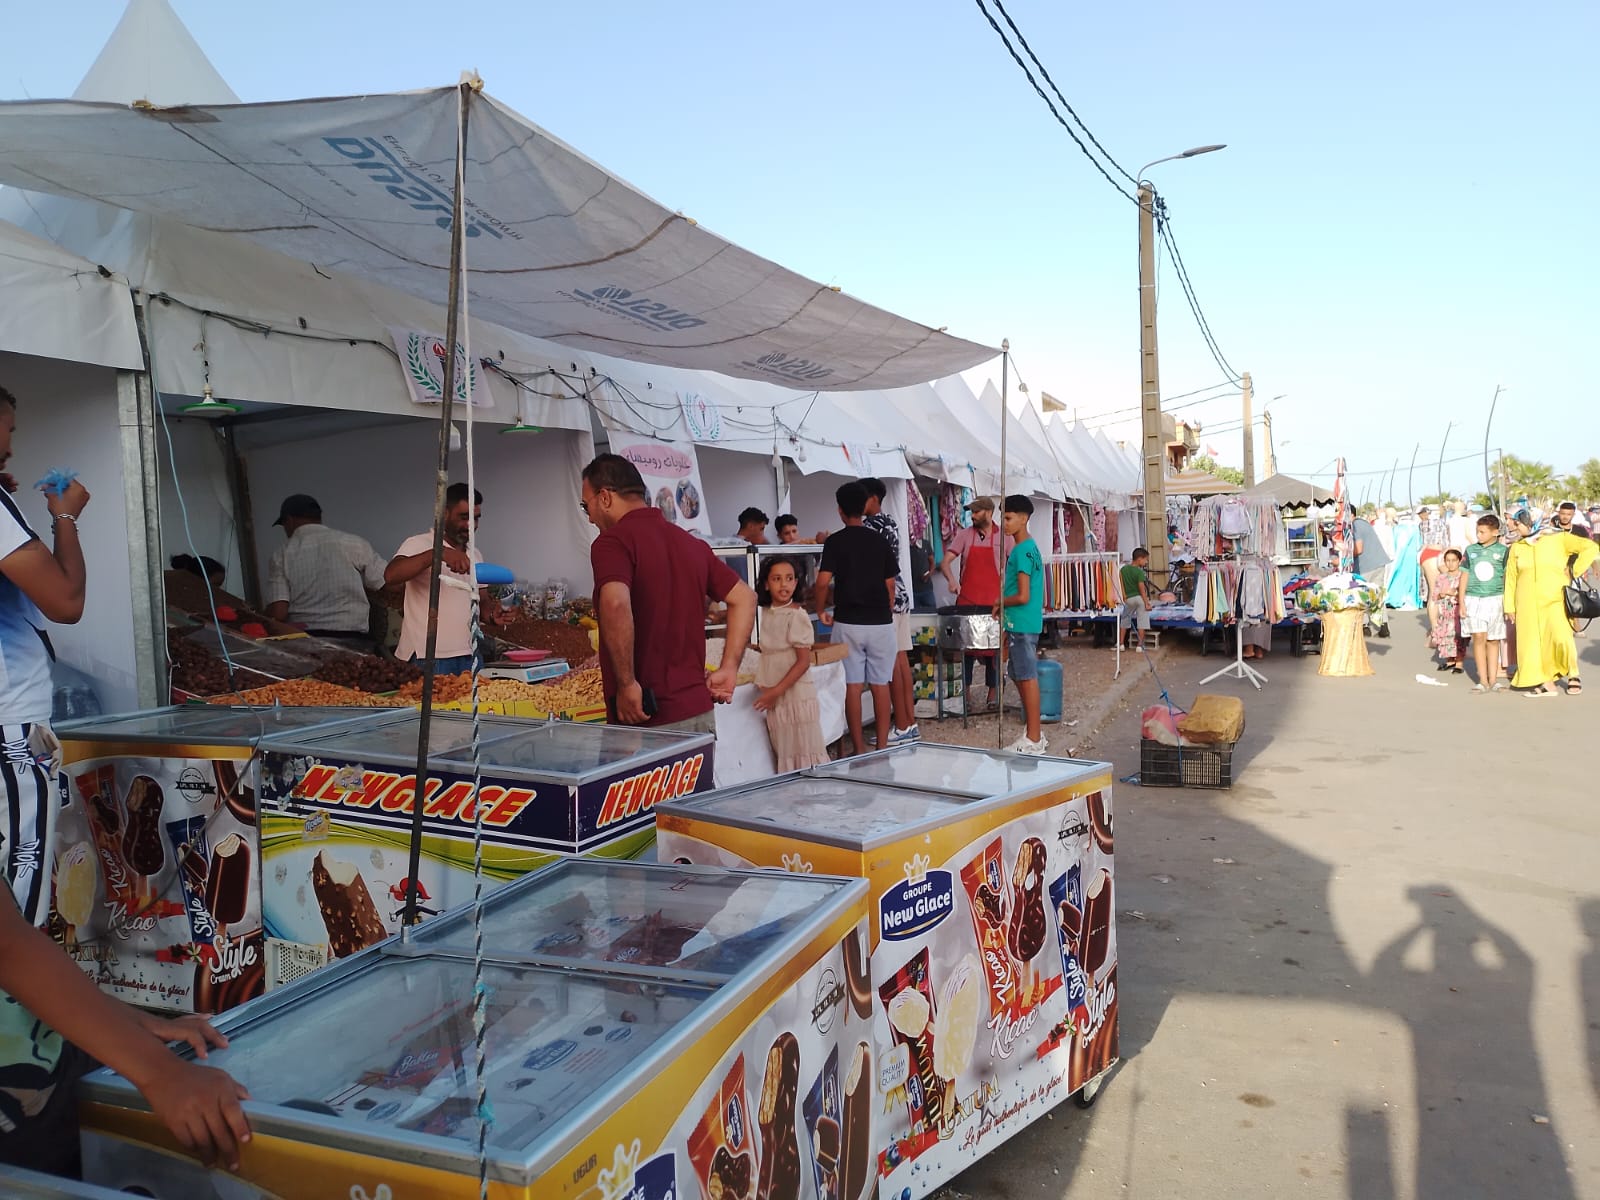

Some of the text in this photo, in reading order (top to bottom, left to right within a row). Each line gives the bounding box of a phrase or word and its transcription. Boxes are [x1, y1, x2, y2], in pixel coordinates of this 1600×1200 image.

[599, 754, 704, 828] NEWGLACE
[883, 892, 951, 931] New Glace
[902, 882, 933, 901] GROUPE
[104, 900, 156, 940] Kicao
[193, 897, 214, 937] Style
[208, 934, 258, 978] Style
[1065, 958, 1085, 1000] Style
[1081, 975, 1116, 1035] Style
[987, 1006, 1039, 1060] Kicao
[573, 1153, 598, 1184] UGUR
